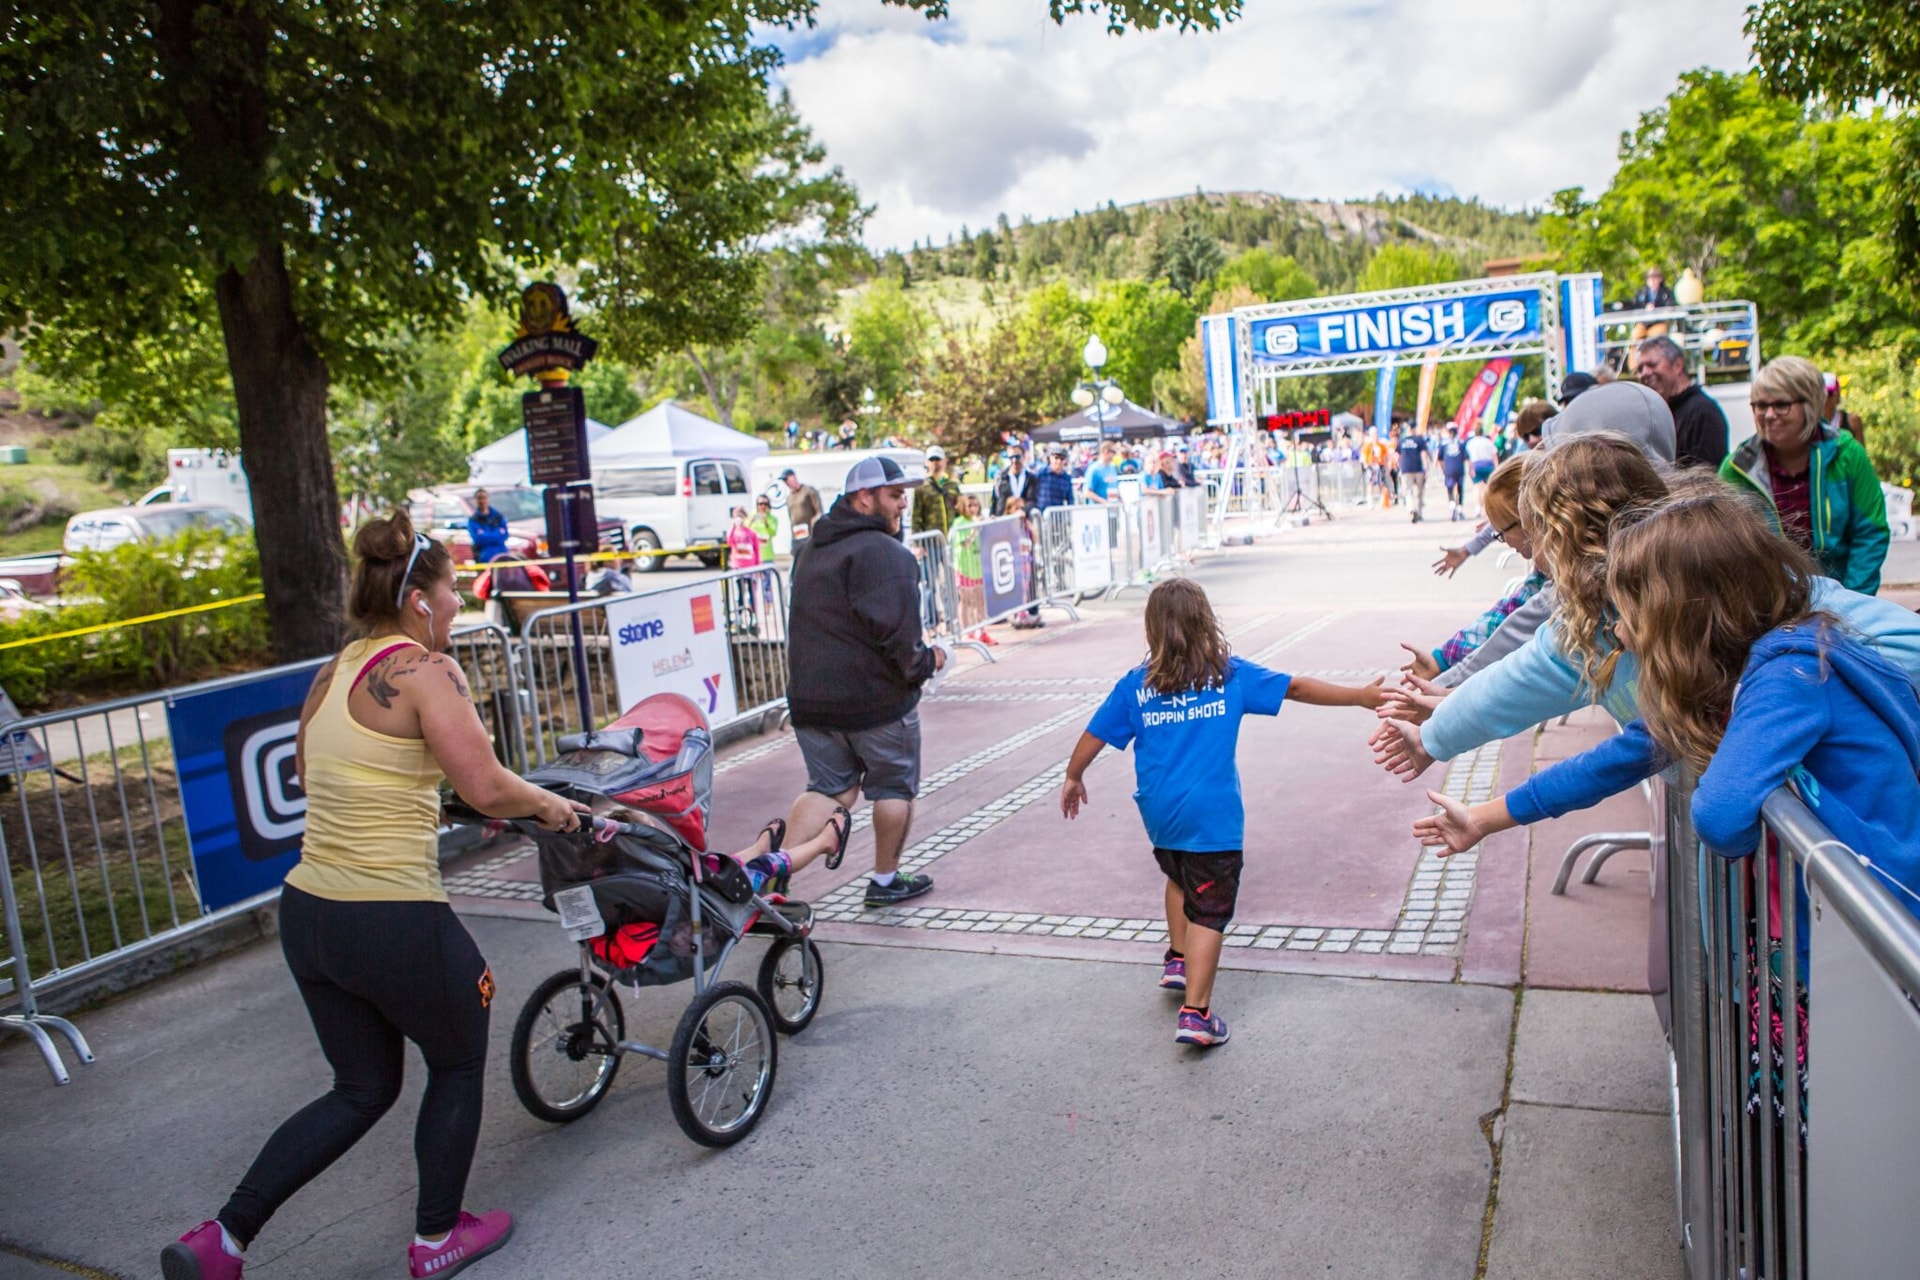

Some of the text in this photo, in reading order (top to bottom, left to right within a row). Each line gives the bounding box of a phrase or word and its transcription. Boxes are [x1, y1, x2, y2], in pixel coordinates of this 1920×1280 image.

[1318, 301, 1465, 354] FINISH
[552, 336, 582, 357] MALL
[618, 619, 664, 646] stone
[652, 647, 694, 673] HELENA
[1142, 699, 1226, 728] DROPPIN SHOTS
[424, 1246, 465, 1273] NOBULL
